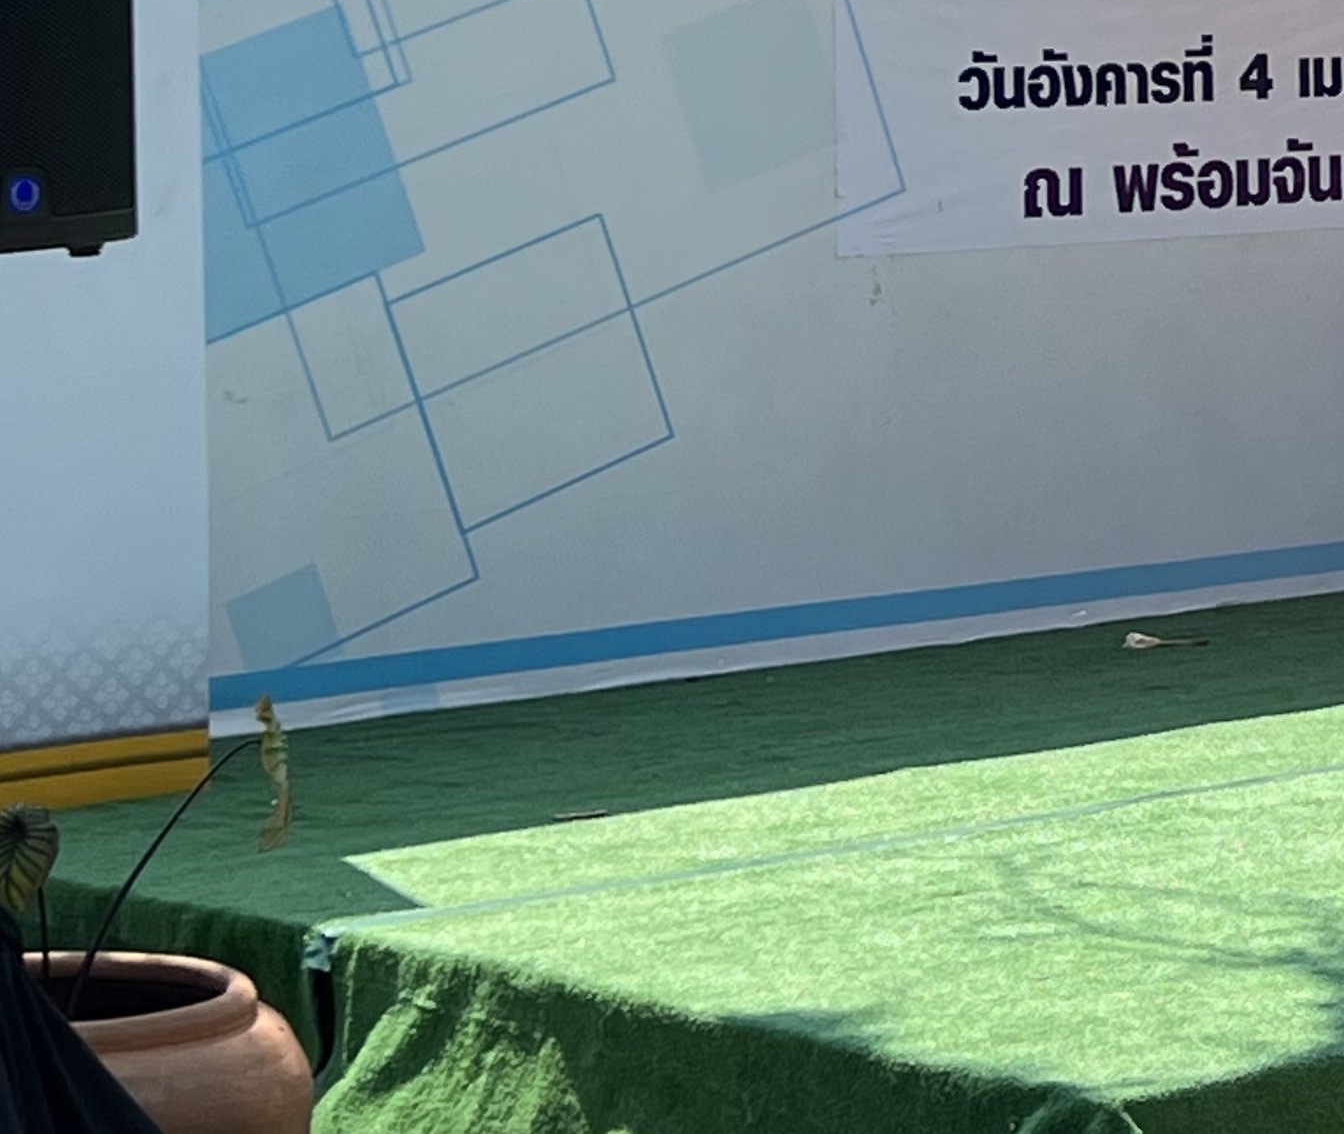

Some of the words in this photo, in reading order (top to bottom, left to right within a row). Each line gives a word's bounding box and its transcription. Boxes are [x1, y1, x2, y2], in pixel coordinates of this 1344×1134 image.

[957, 34, 1214, 111] วันอังคารที่
[1239, 53, 1274, 101] 4
[1023, 166, 1084, 219] ณ
